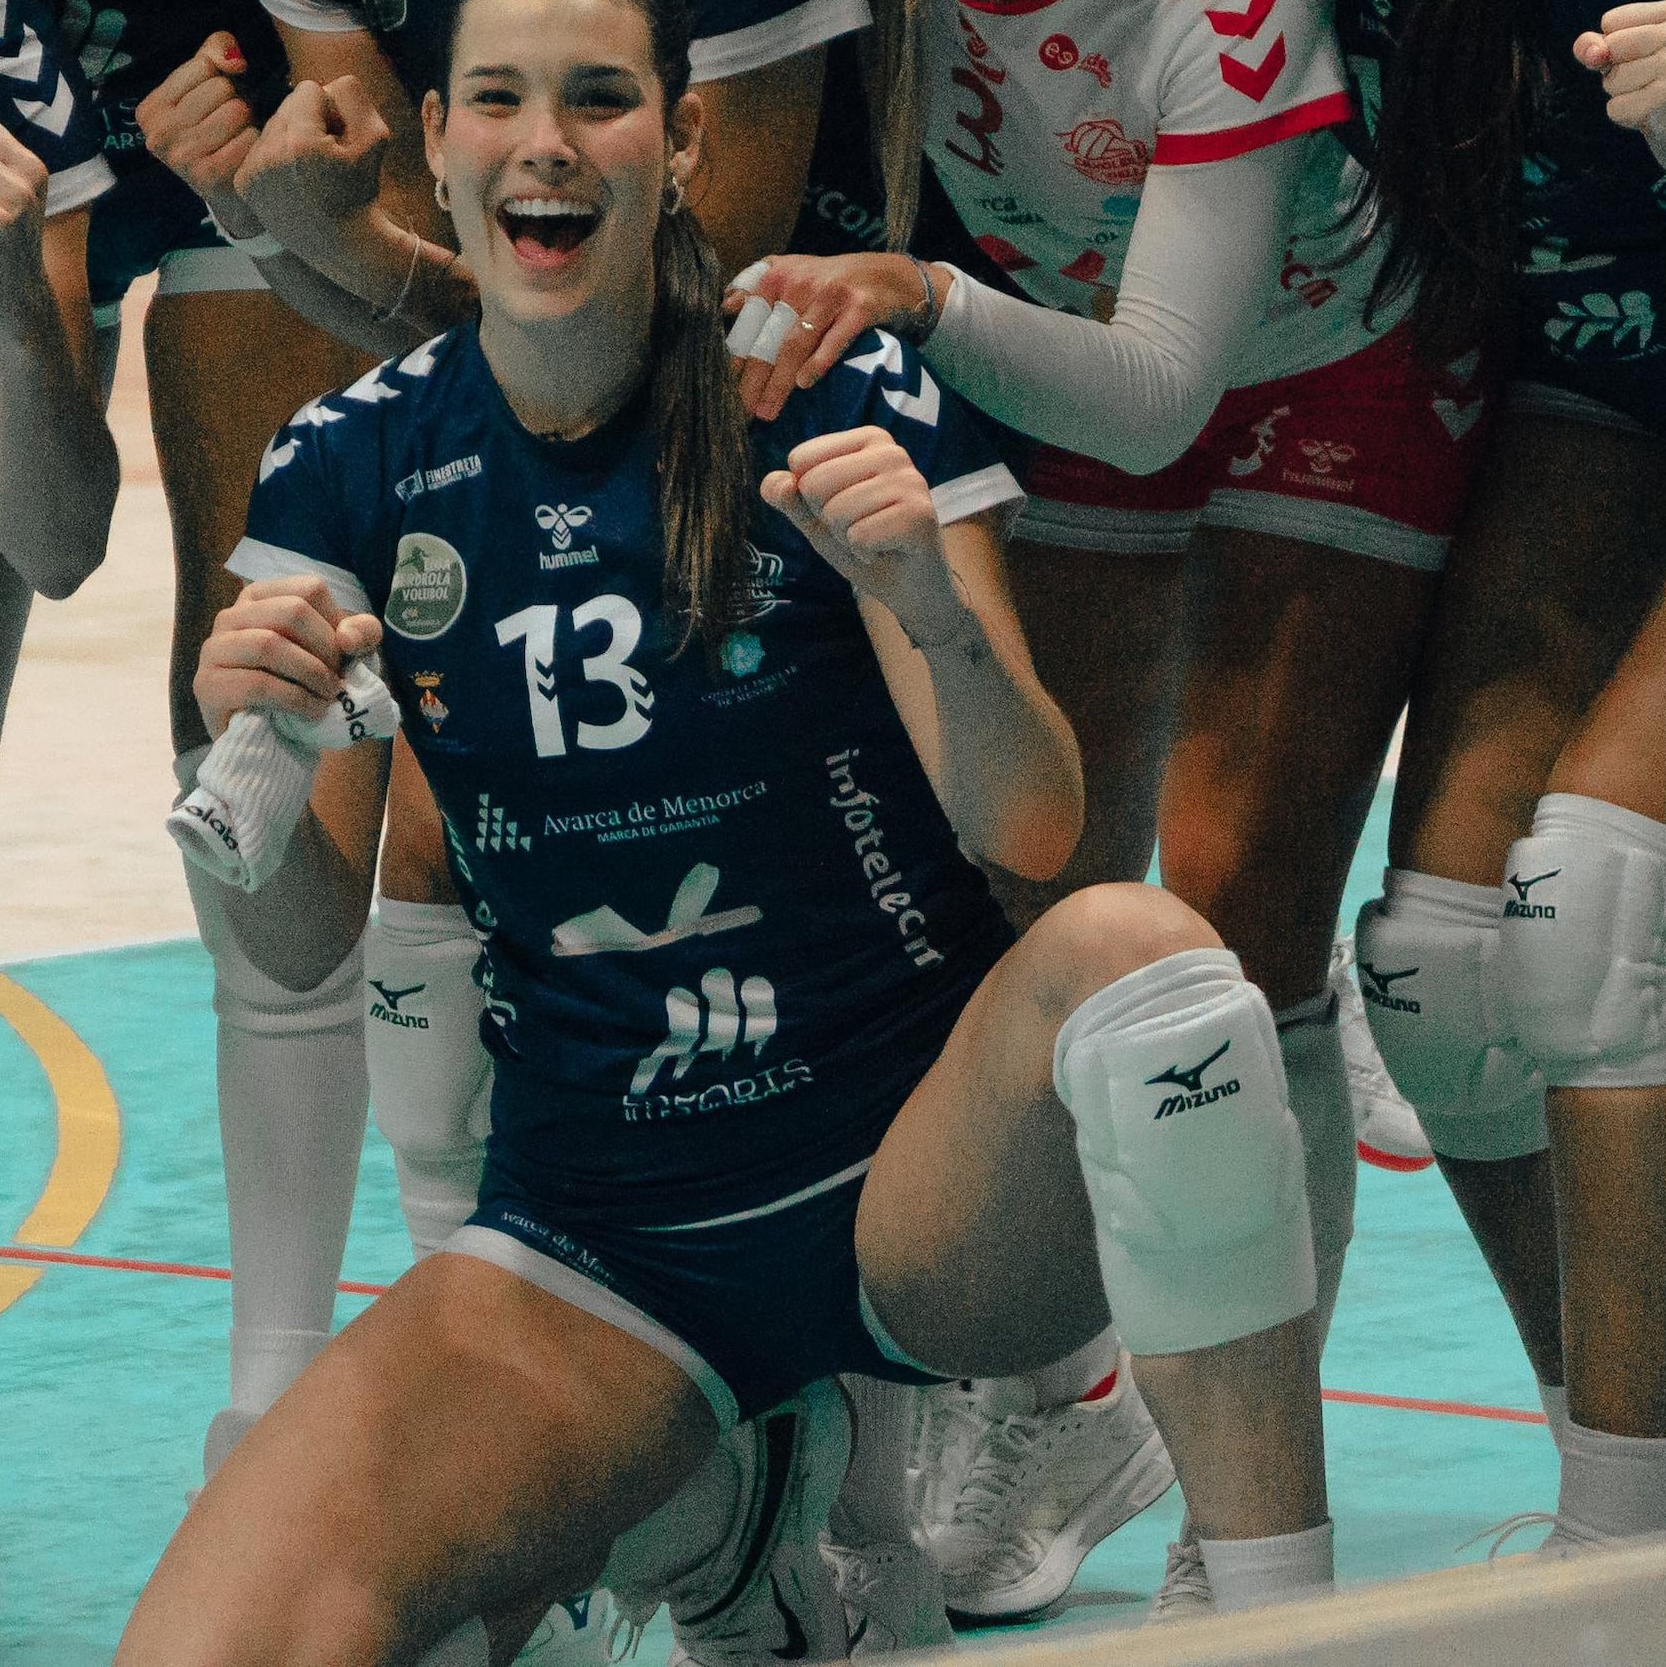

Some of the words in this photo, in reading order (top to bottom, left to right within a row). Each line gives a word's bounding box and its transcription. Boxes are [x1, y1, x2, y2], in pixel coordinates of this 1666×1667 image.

[539, 544, 599, 570] hummel
[493, 594, 655, 758] 13
[543, 808, 622, 837] Avarca
[627, 801, 657, 822] de
[663, 778, 768, 819] Menorca
[597, 827, 639, 844] MARCA
[641, 824, 658, 839] DE
[500, 1209, 550, 1237] varca
